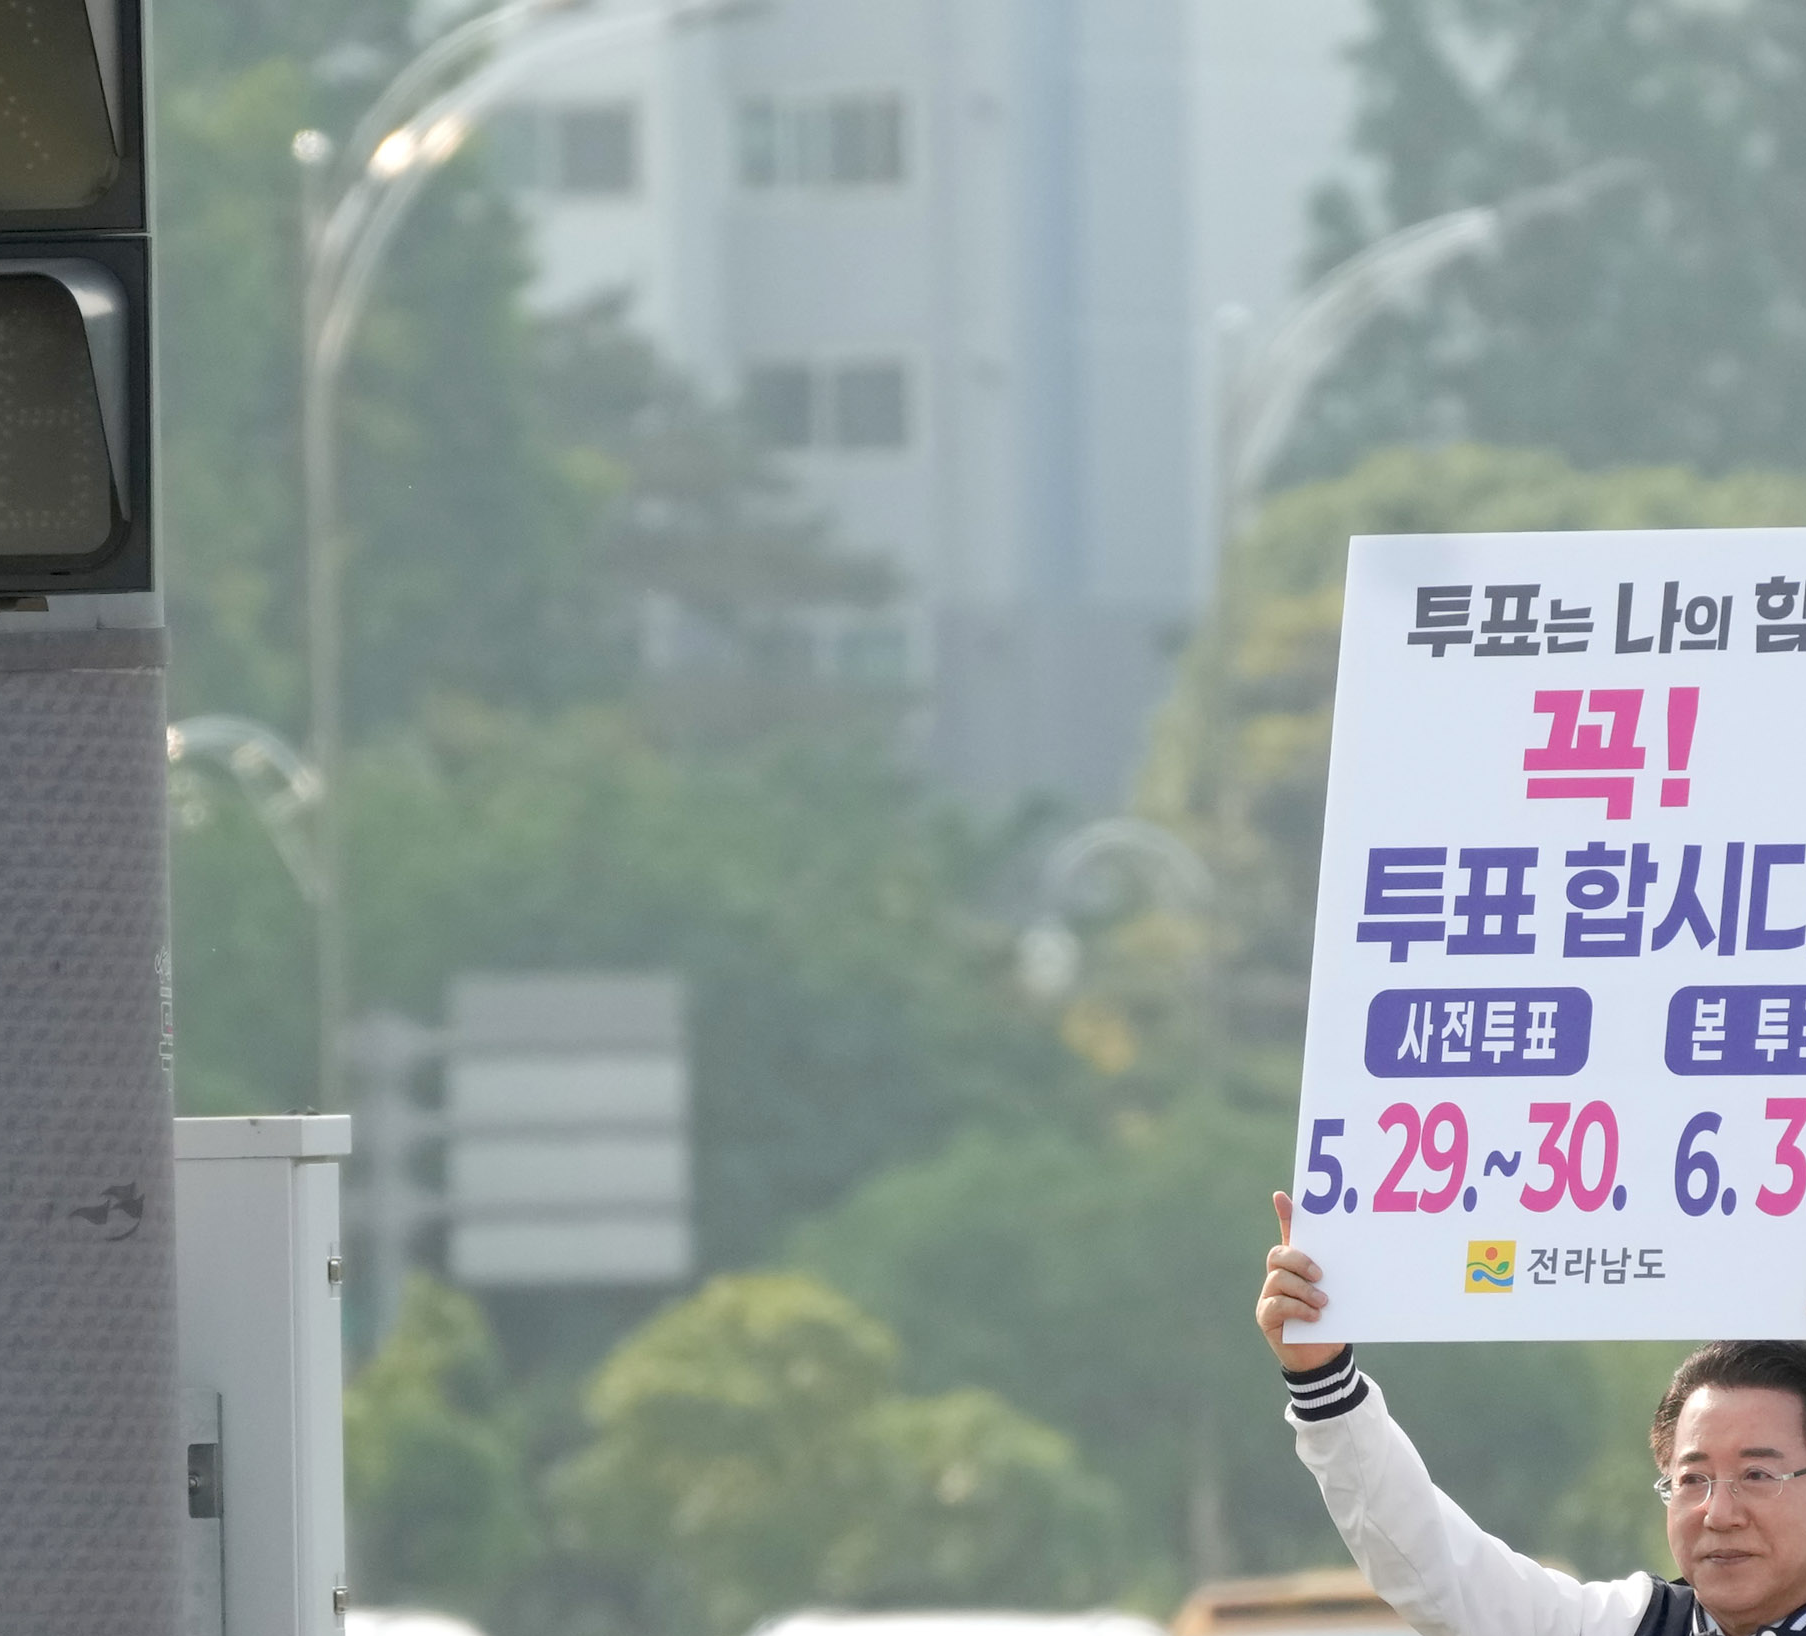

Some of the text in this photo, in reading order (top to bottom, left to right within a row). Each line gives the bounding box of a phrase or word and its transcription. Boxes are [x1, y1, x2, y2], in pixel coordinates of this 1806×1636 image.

[1407, 583, 1595, 658] 투표는
[1614, 580, 1734, 655] 나의
[1522, 686, 1700, 821] 꼭!
[1355, 846, 1540, 963] 투표
[1397, 1001, 1558, 1064] 사전투표
[1526, 1247, 1666, 1285] 전라남도
